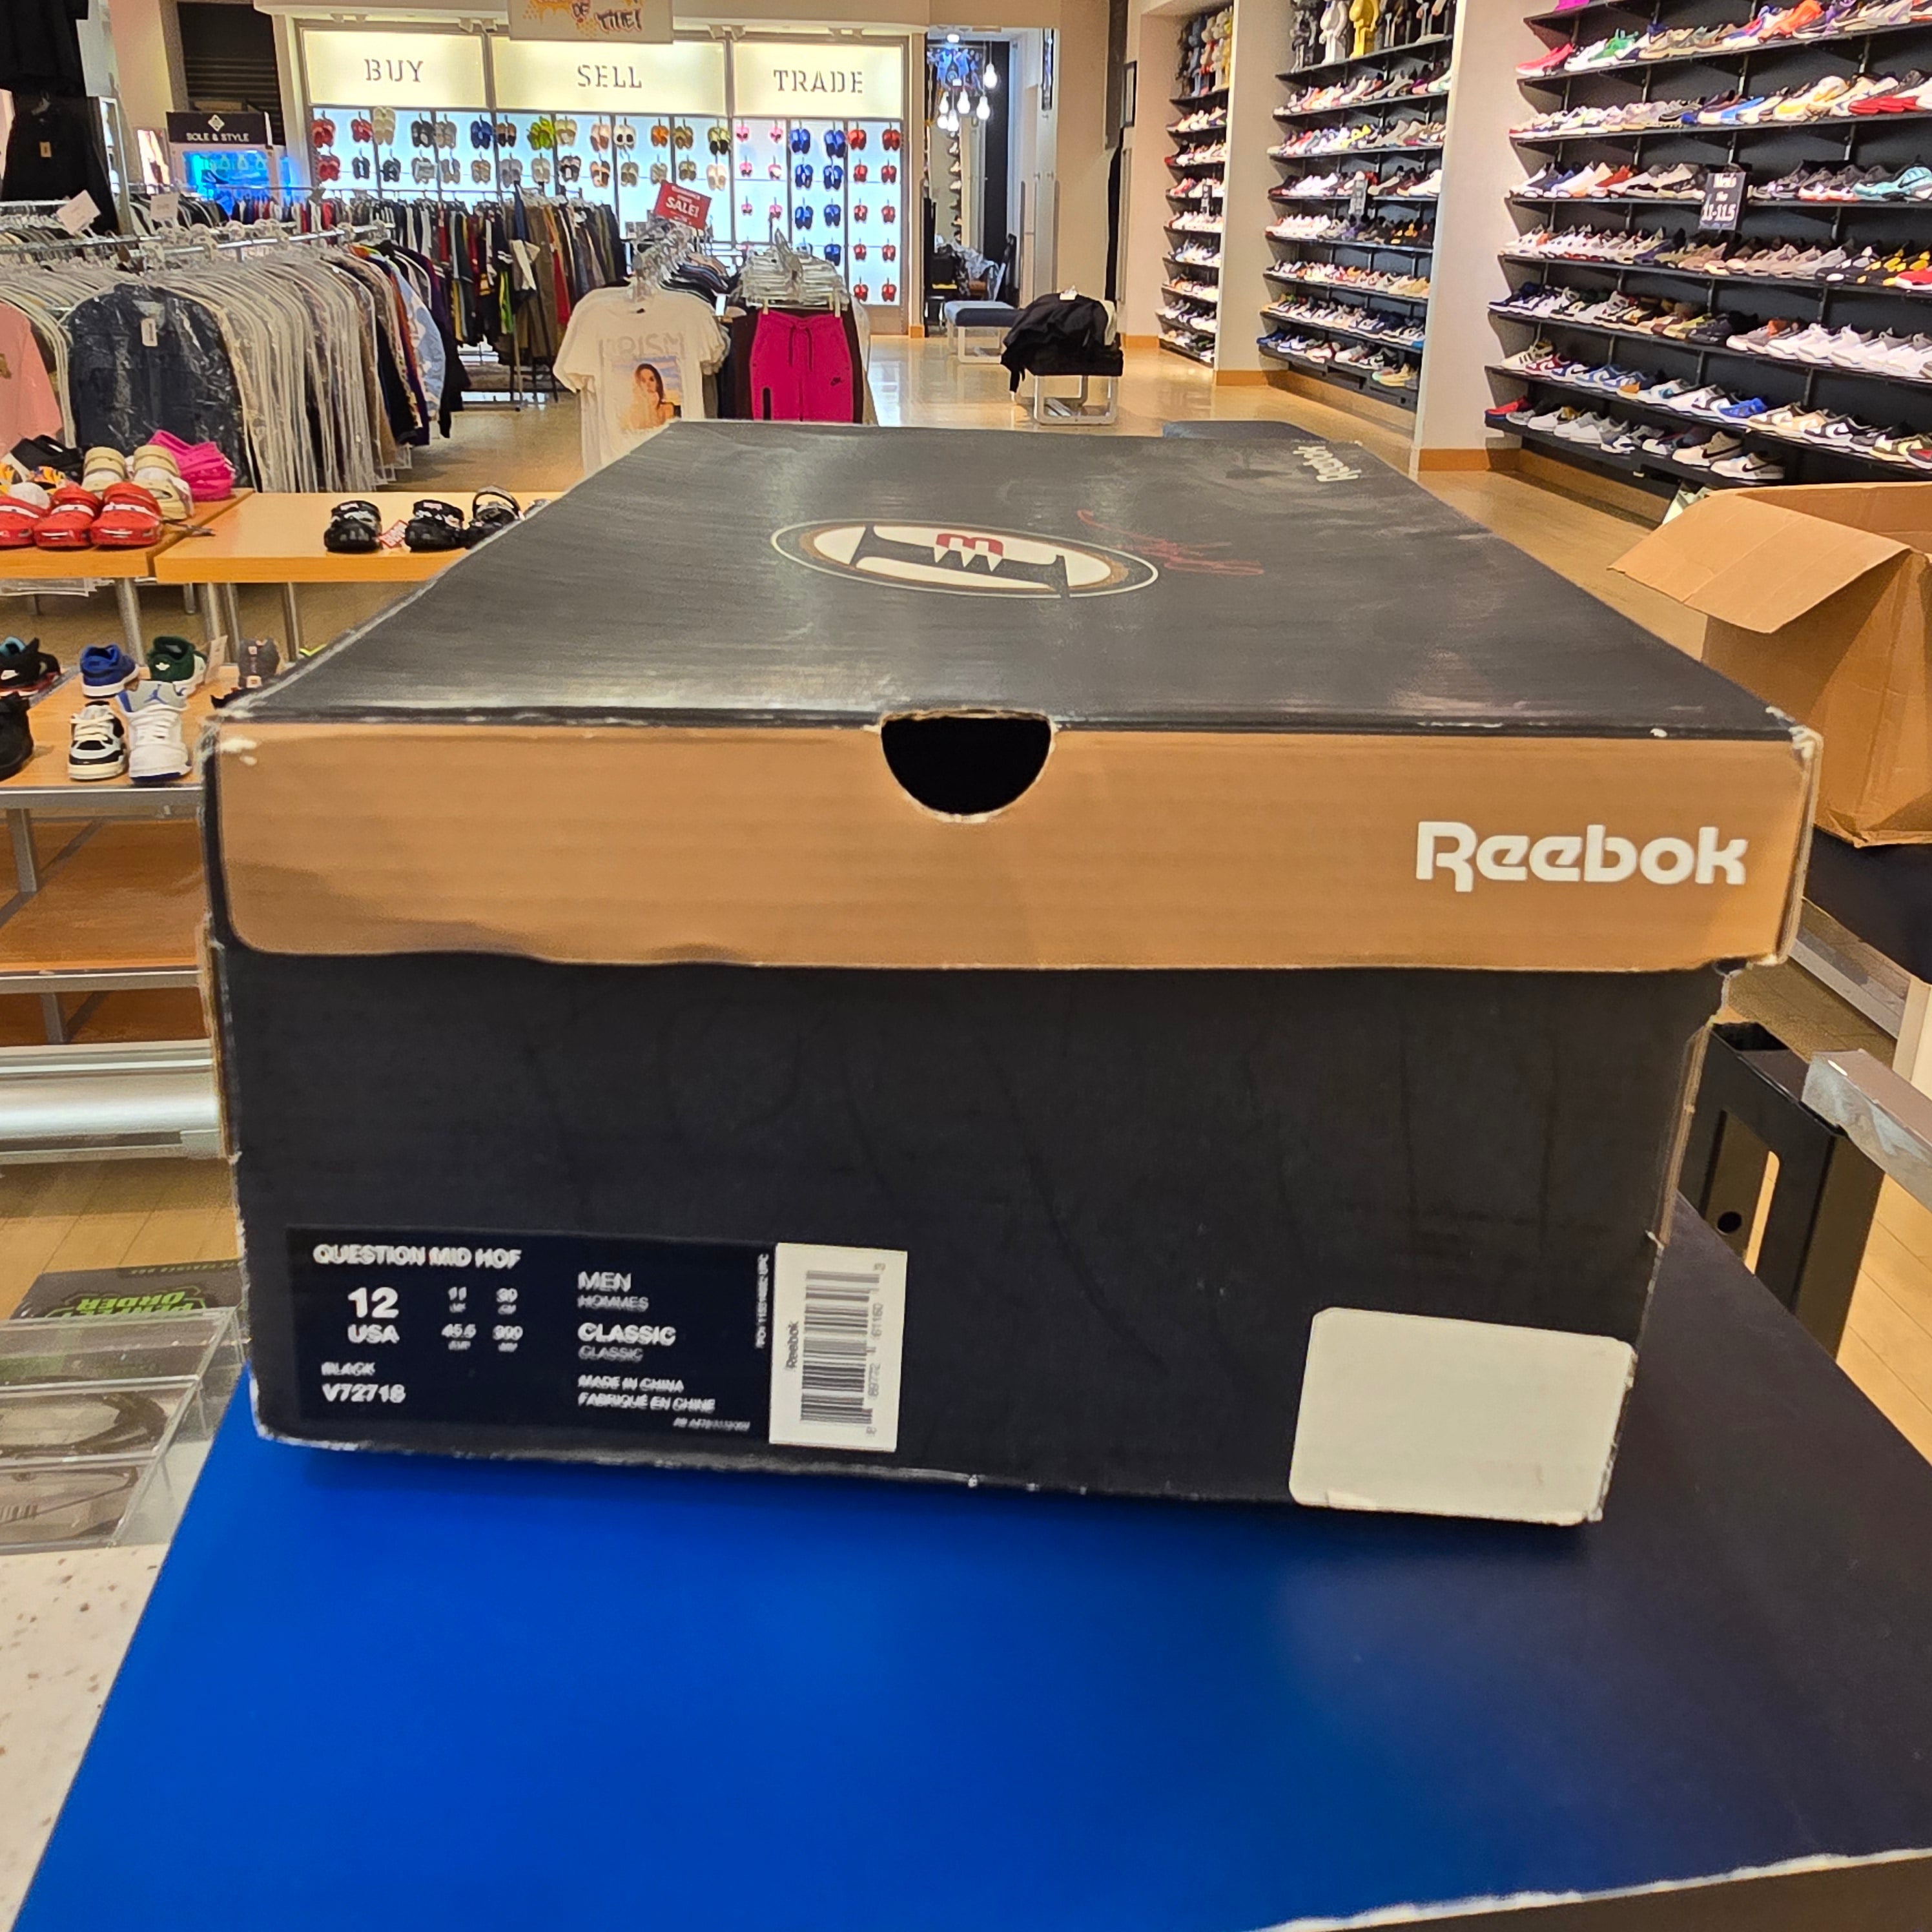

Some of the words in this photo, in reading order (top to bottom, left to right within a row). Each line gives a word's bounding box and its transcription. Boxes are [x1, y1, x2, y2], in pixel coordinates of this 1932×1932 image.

[364, 57, 424, 84] BUY
[576, 64, 643, 90] SELL
[773, 68, 865, 94] TRADE
[186, 132, 209, 141] SOLE
[221, 133, 249, 142] STYLE
[666, 196, 700, 218] SALE!
[1416, 821, 1749, 892] Reebok
[313, 1244, 426, 1266] QUESTION
[429, 1247, 472, 1267] MID
[475, 1248, 522, 1269] HOF
[578, 1271, 632, 1292] MEN
[76, 1291, 185, 1311] ORDER
[347, 1287, 399, 1318] 12
[448, 1287, 467, 1300] 11
[577, 1295, 649, 1311] HOMMES
[347, 1324, 400, 1343] USA
[578, 1322, 676, 1346] CLASSIC
[578, 1345, 643, 1362] CLASSIC
[784, 1321, 799, 1372] Reebok
[322, 1362, 375, 1376] BLACK
[578, 1375, 621, 1390] MADE
[622, 1377, 637, 1390] IN
[639, 1377, 684, 1393] CHINA
[650, 1397, 671, 1411] EN
[672, 1397, 715, 1413] CHINE
